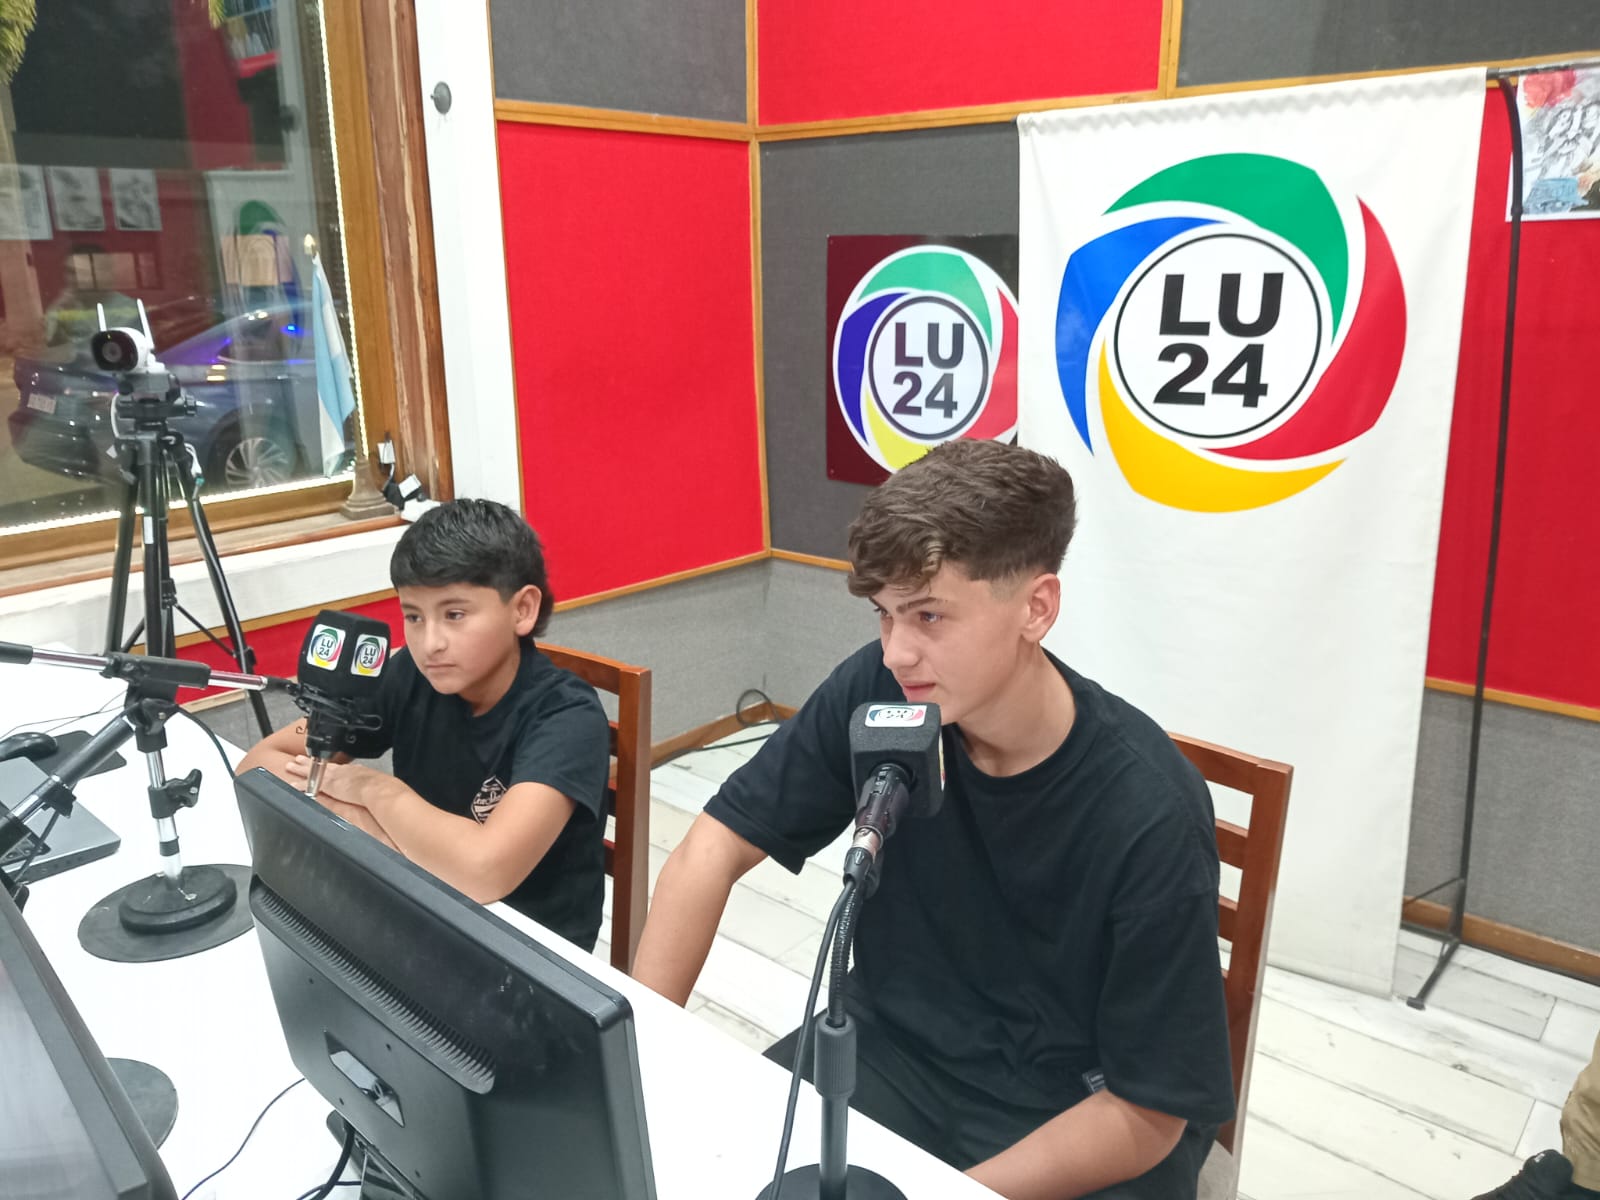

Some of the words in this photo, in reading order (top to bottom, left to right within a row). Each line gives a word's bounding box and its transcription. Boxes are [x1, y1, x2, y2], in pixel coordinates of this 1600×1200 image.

[1158, 272, 1284, 338] LU
[894, 322, 966, 369] LU
[1153, 343, 1268, 408] 24
[891, 371, 958, 418] 24
[319, 646, 331, 657] 24
[320, 638, 334, 648] LU
[364, 647, 377, 657] LU
[362, 655, 374, 665] 24
